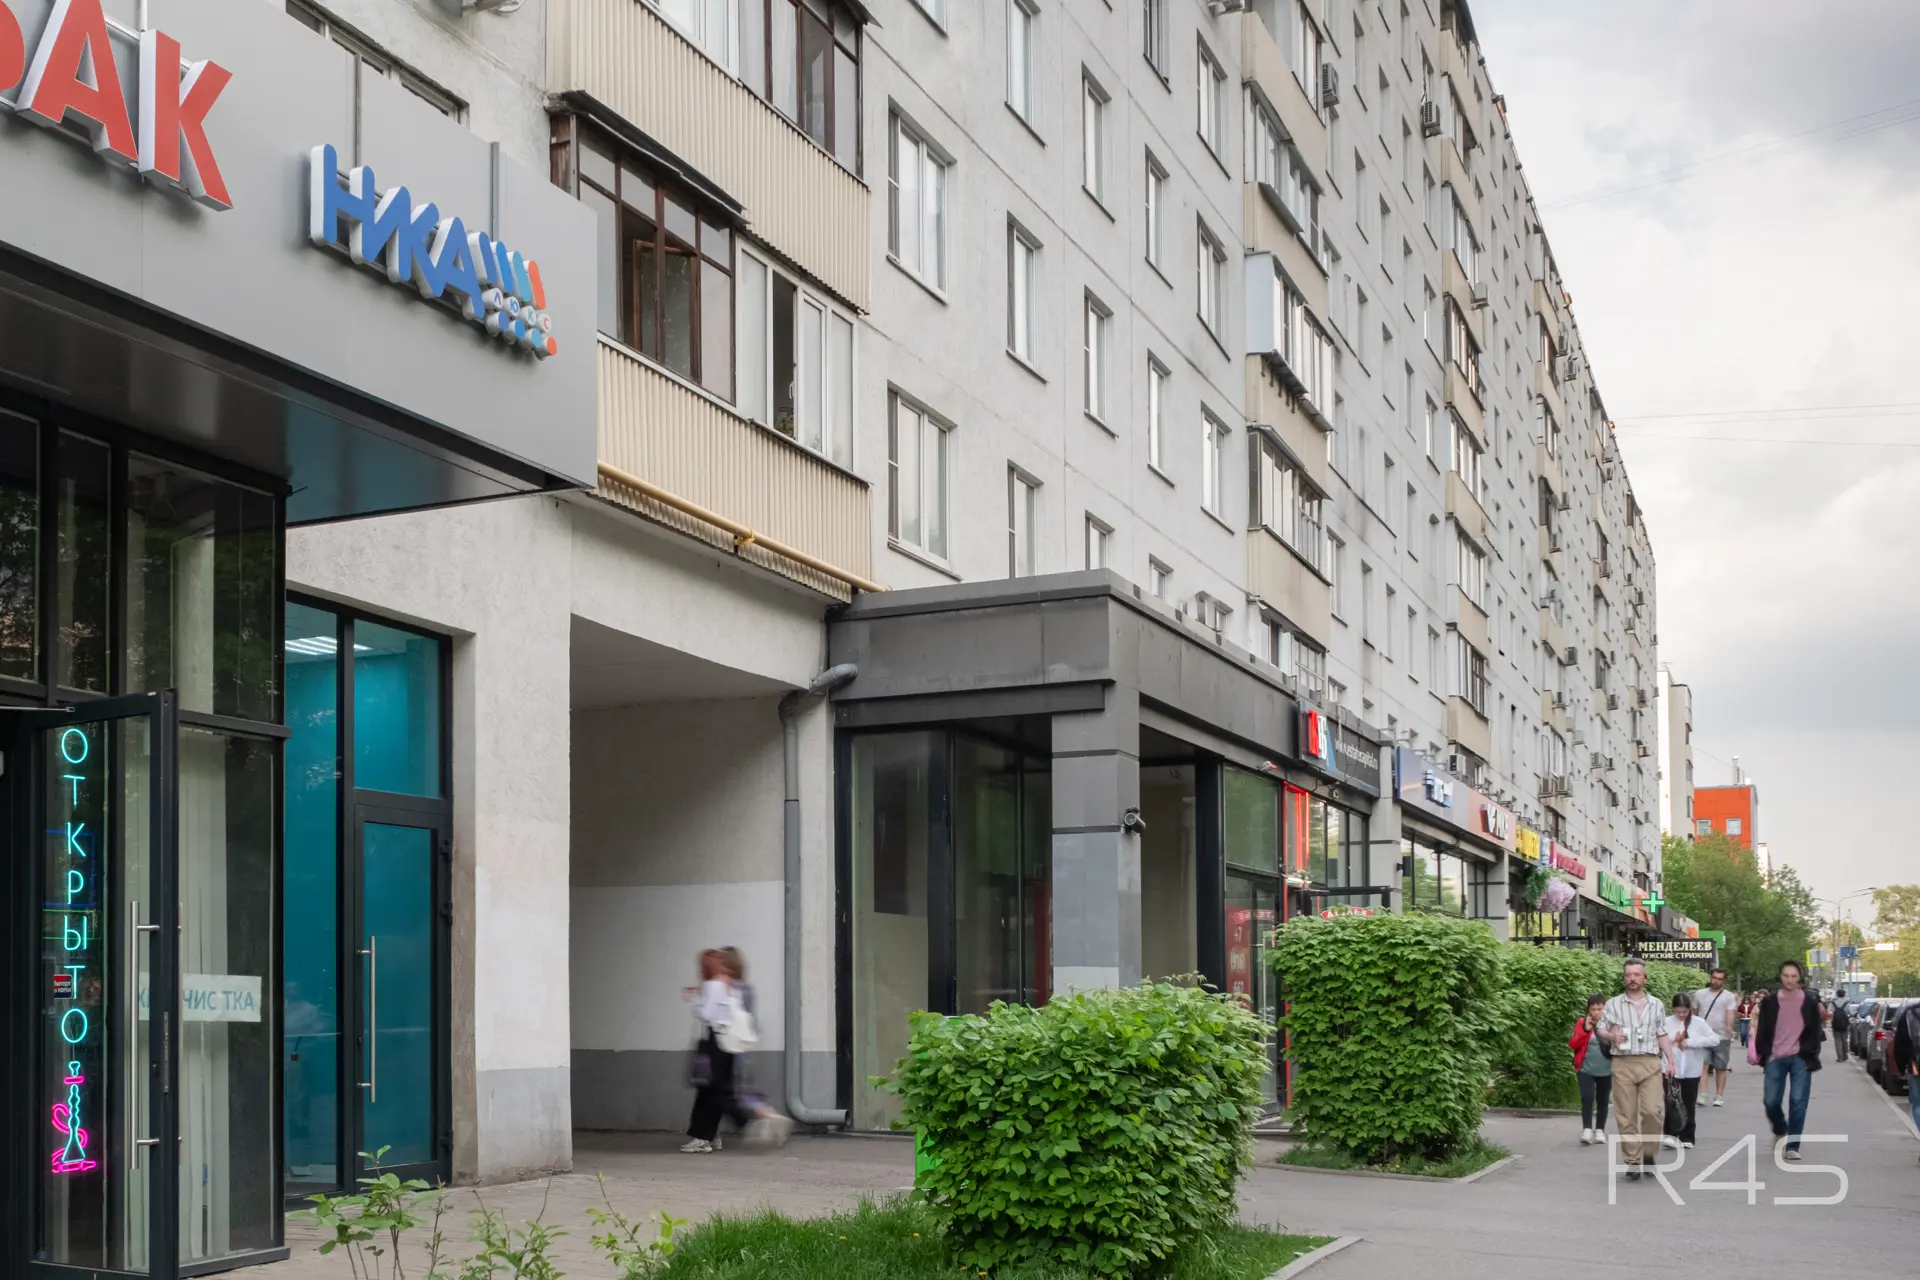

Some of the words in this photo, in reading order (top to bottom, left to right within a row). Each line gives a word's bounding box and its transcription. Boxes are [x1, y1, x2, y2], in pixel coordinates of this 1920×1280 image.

[0, 0, 233, 212] АК
[311, 143, 486, 321] НИКА
[493, 291, 550, 331] ЛЮКС
[61, 728, 88, 1043] ОТКРЫТО
[1638, 941, 1712, 953] МЕНДЕЛЕЕВ
